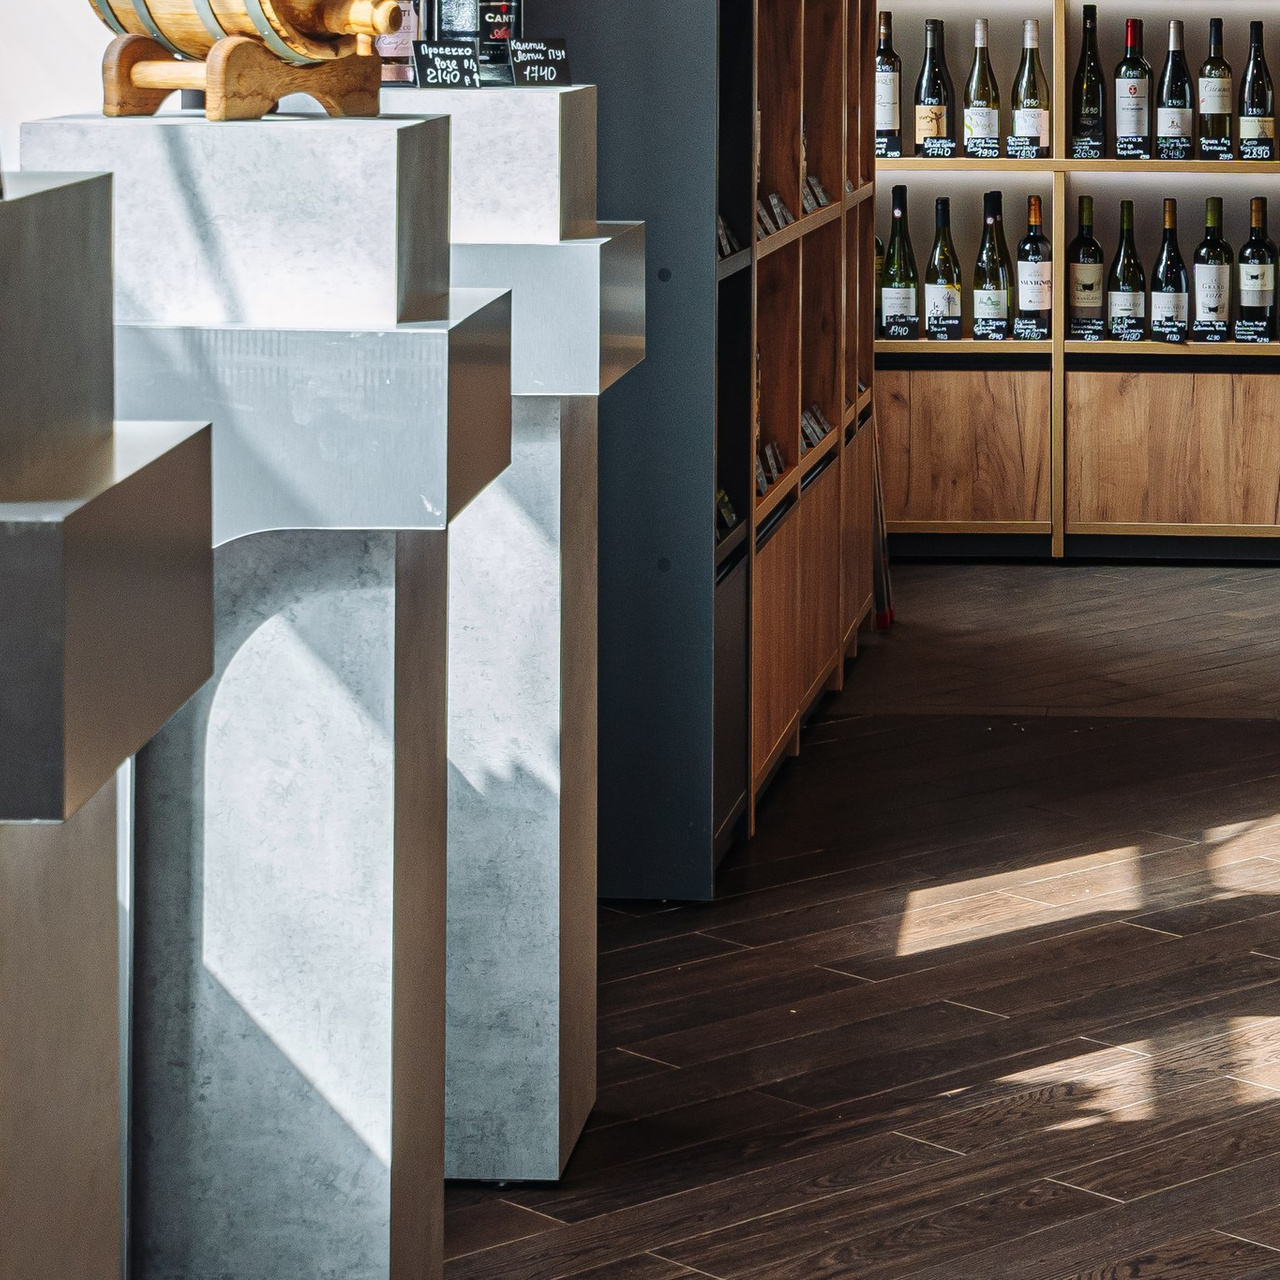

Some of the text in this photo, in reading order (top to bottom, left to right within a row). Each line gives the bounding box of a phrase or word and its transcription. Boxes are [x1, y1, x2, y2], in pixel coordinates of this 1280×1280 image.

[511, 40, 546, 51] Канти
[421, 44, 472, 59] Просекко
[435, 59, 458, 70] Розе
[427, 69, 460, 83] 2140
[524, 65, 557, 81] 1740
[924, 98, 939, 106] 1740
[1023, 99, 1039, 107] 1990
[926, 148, 951, 157] 1740
[975, 148, 999, 157] 1990
[1073, 149, 1100, 158] 2690
[1244, 149, 1271, 159] 2890
[1202, 283, 1225, 291] GRAND
[1120, 332, 1141, 341] 1490
